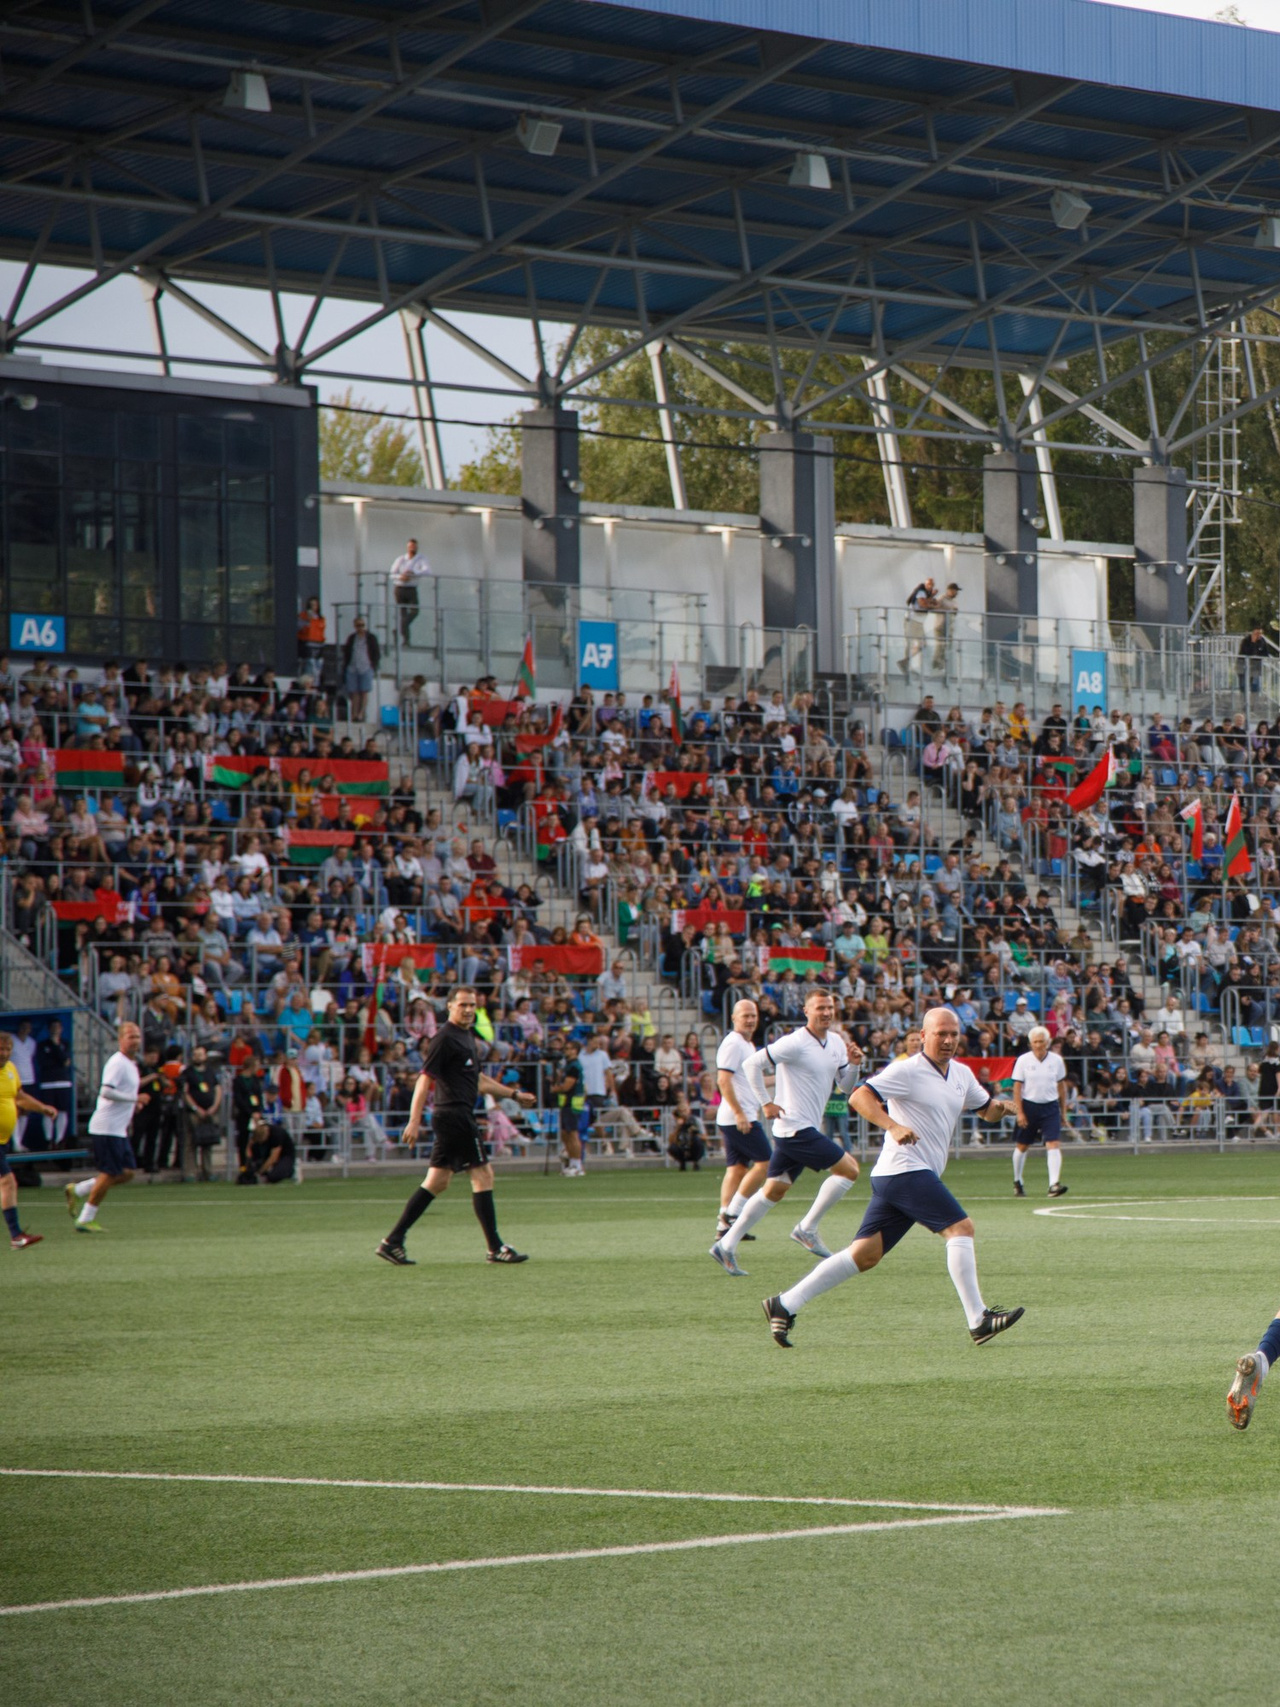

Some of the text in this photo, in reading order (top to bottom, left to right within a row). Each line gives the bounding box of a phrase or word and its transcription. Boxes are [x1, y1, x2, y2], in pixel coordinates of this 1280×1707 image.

[19, 618, 57, 647] A6
[582, 643, 614, 668] A7
[1076, 670, 1103, 694] A8
